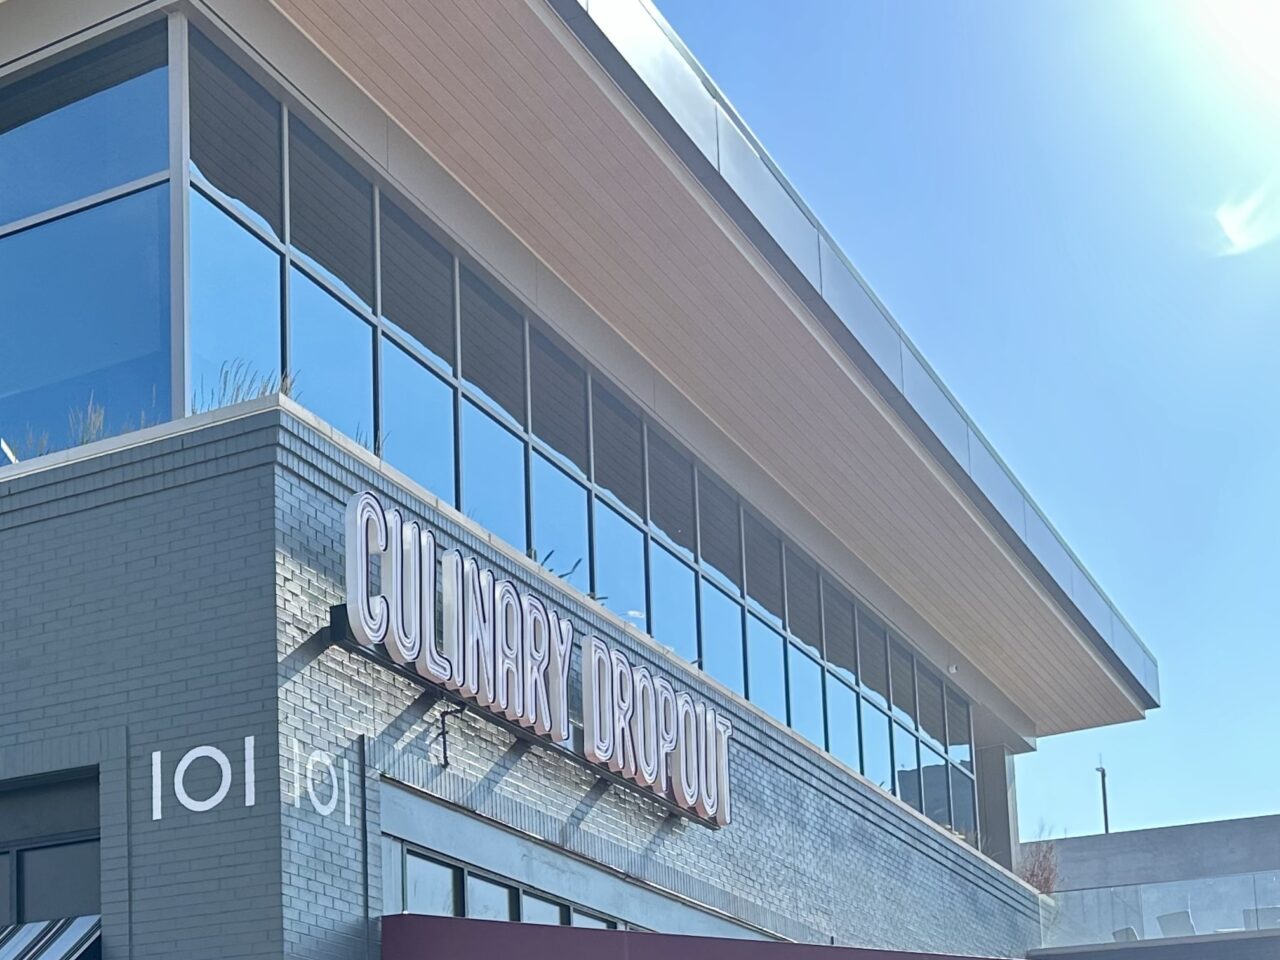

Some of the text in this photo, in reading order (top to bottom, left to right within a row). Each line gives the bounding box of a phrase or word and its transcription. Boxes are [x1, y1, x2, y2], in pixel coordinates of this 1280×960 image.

[345, 490, 734, 826] CULINARY DROPOUT
[151, 734, 256, 820] 101
[293, 737, 351, 826] 101
